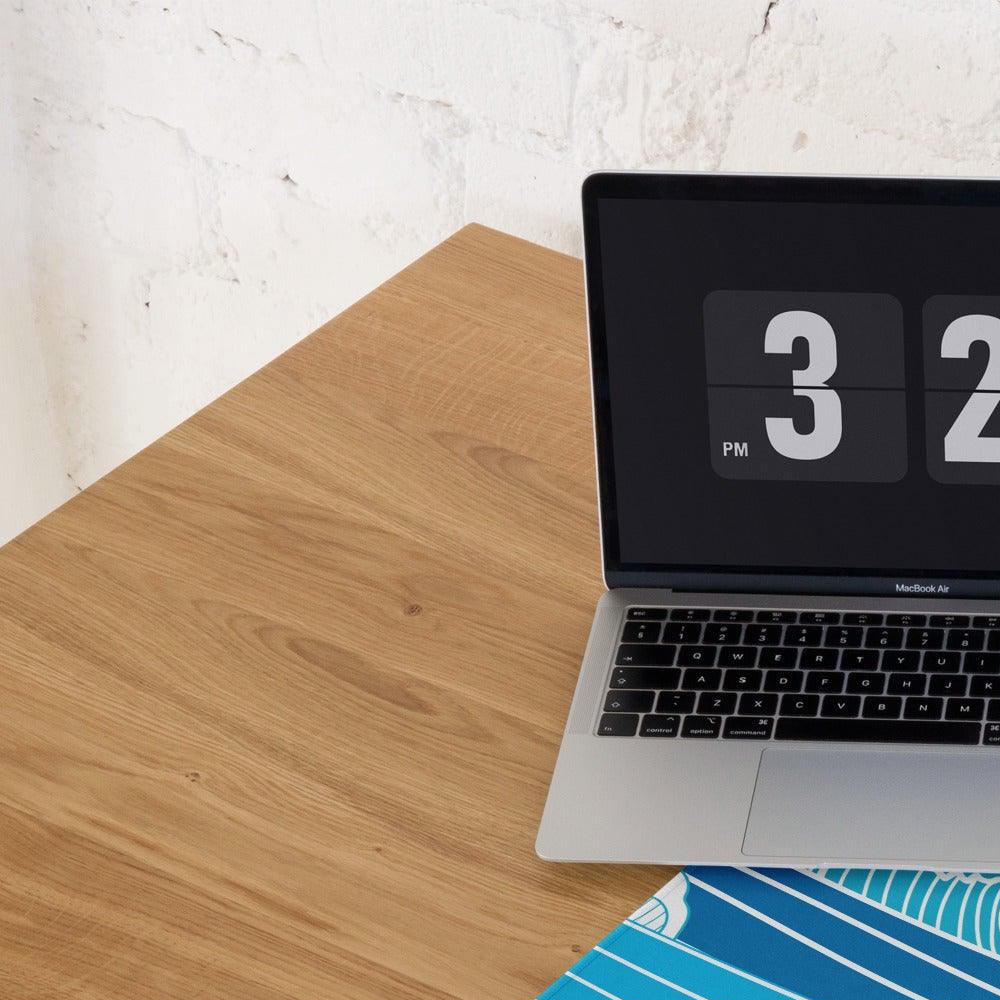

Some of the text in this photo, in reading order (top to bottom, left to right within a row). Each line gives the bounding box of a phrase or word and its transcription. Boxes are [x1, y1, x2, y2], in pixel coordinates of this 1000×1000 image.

[764, 311, 842, 461] 3
[723, 442, 749, 457] PM
[895, 583, 950, 593] MacBook Air
